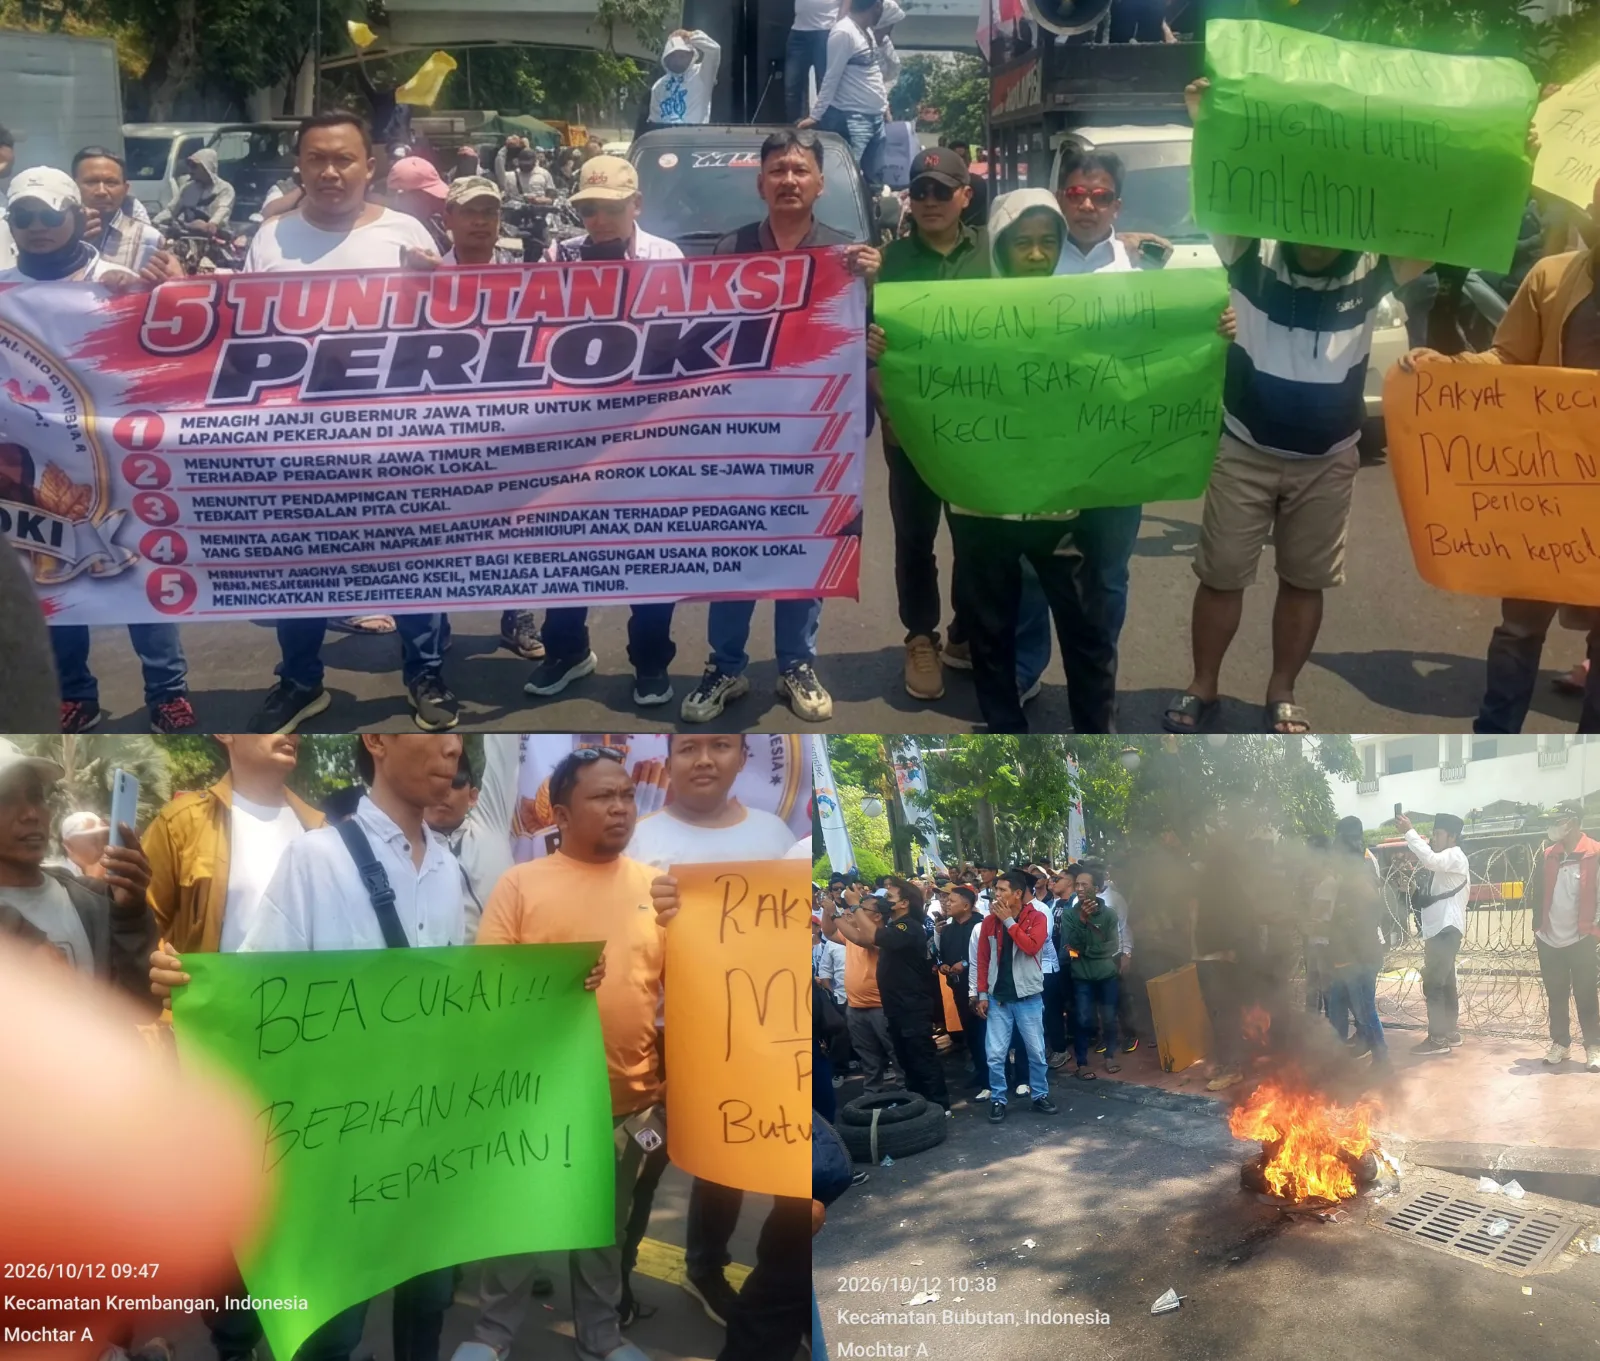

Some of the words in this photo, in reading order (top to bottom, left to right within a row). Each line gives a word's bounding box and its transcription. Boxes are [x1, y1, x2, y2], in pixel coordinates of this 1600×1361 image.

[139, 279, 221, 356] 5
[227, 264, 626, 335] TUNTUTAN
[631, 254, 815, 318] AKSI
[900, 294, 1036, 350] JANGAN
[1049, 291, 1157, 335] BUNUH
[205, 312, 781, 406] PERLOKI
[917, 362, 1004, 401] USAHA
[1017, 348, 1163, 397] RAKYAT
[180, 414, 260, 429] MENAGIH
[264, 411, 314, 426] JANJI
[422, 405, 472, 420] JAWA
[476, 402, 530, 417] TIMUR
[534, 400, 592, 415] UNTUK
[596, 383, 733, 412] MEMPERBANYAK
[1078, 402, 1139, 435] MAK
[129, 418, 149, 447] 1
[178, 430, 269, 446] LAPANGAN
[273, 426, 372, 442] PEKERJAAN
[376, 425, 393, 438] DI
[398, 422, 446, 437] JAWA
[449, 420, 505, 435] TIMUR.
[183, 456, 277, 470] MENUNTUT
[428, 447, 482, 461] TIMUR
[486, 435, 597, 458] MEMBERIKAN
[601, 422, 722, 445] PERLINDUNGAN
[726, 421, 781, 434] HUKUM
[932, 414, 1028, 446] KECIL
[133, 459, 159, 486] 2
[192, 494, 277, 508] MENUNTUT
[410, 482, 494, 500] TERHADAP
[649, 464, 697, 478] LOKAL
[700, 463, 766, 476] SE-JAWA
[769, 463, 815, 476] TIMUR
[143, 496, 167, 522] 3
[200, 532, 265, 546] MEMINTA
[314, 529, 360, 542] TIDAK
[515, 508, 610, 525] PENINDAKAN
[614, 506, 689, 520] TERHADAP
[692, 505, 767, 517] PEDAGANG
[770, 503, 809, 516] KECIL
[361, 504, 397, 517] PITA
[150, 535, 175, 562] 4
[202, 546, 240, 559] YANG
[244, 544, 304, 557] SEDANG
[633, 521, 664, 534] DAN
[475, 554, 509, 567] BAGI
[513, 548, 656, 565] KEBERLANGSUNGAN
[762, 544, 807, 557] LOKAL
[1424, 523, 1511, 560] Butuh
[712, 560, 742, 573] DAN
[159, 573, 185, 606] 5
[446, 582, 539, 598] MASYARAKAT
[541, 581, 580, 594] JAWA
[250, 975, 367, 1060] BEA
[255, 1082, 456, 1174] BERIKAN
[464, 1069, 542, 1117] KAMI
